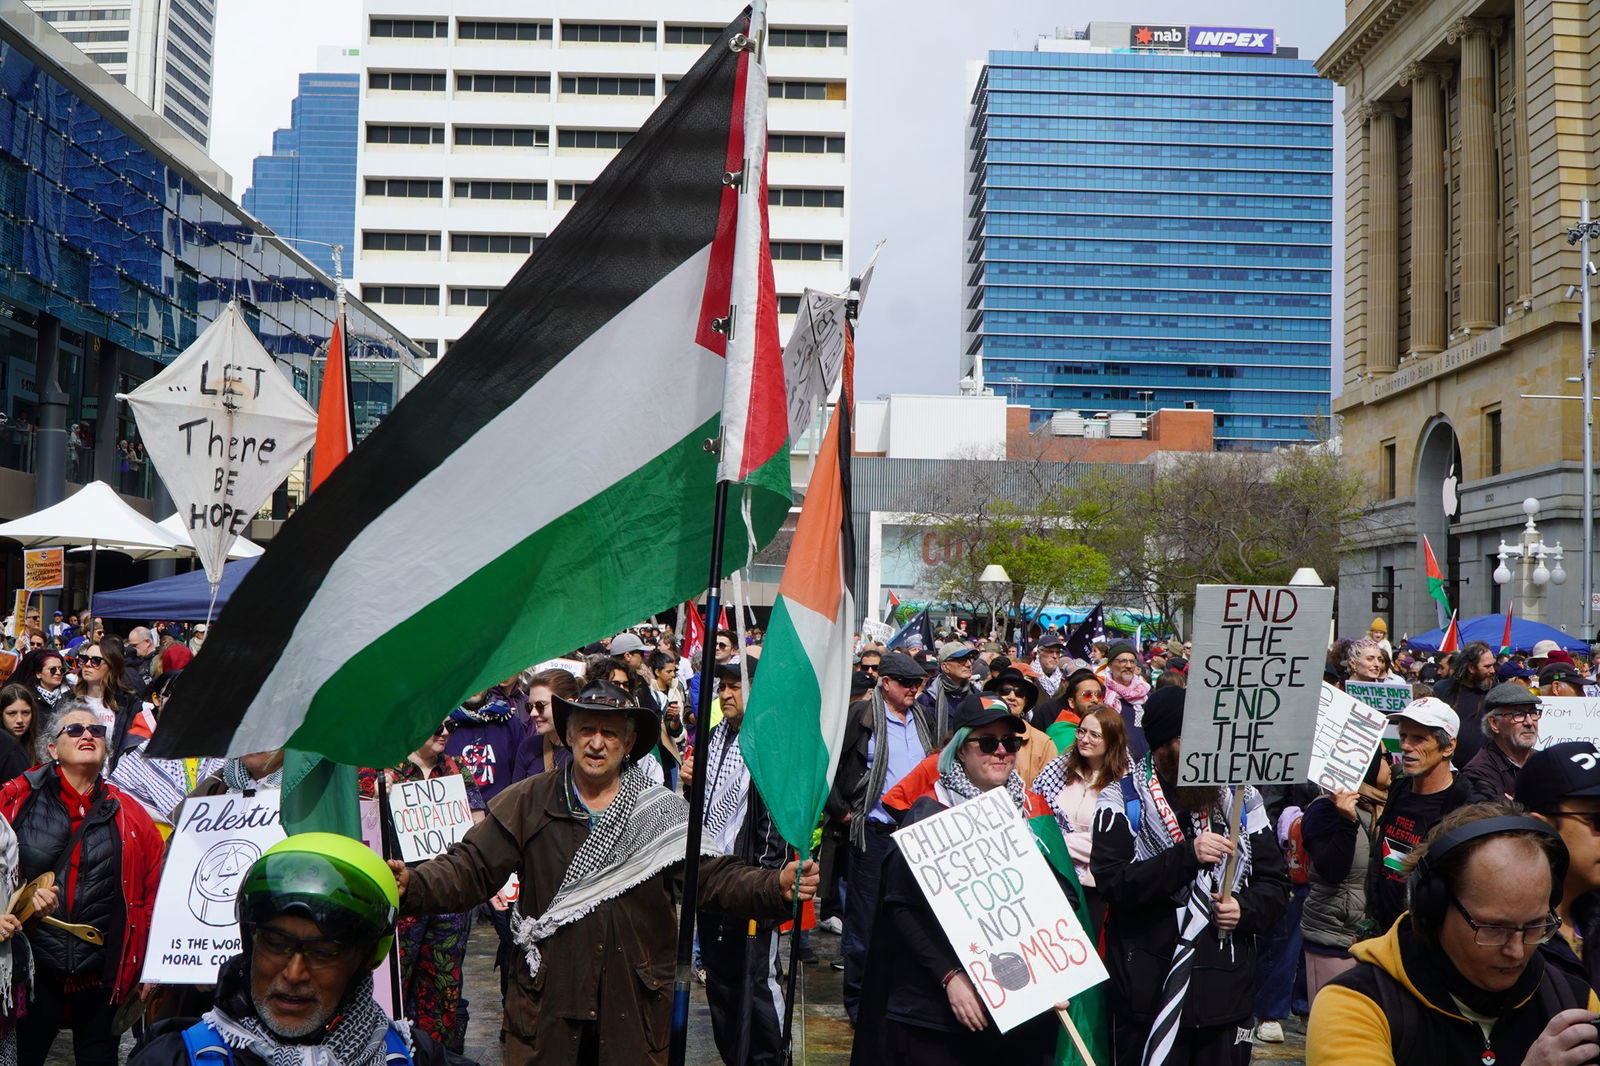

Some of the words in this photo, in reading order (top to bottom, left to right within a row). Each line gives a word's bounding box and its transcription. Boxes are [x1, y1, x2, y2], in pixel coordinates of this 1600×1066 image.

[1154, 28, 1182, 42] nab
[1194, 31, 1268, 47] INPEX
[200, 360, 266, 400] LET
[178, 417, 277, 465] There
[213, 467, 239, 496] BE
[189, 502, 249, 537] HOPE
[1224, 588, 1298, 624] END
[1221, 624, 1293, 656] THE
[1204, 655, 1309, 688] SIEGE
[1212, 687, 1280, 721] END
[1346, 684, 1369, 696] FROM
[1369, 686, 1386, 698] THE
[1386, 687, 1412, 699] RIVER
[1363, 696, 1384, 708] THE
[1386, 698, 1406, 710] SEA
[1212, 721, 1274, 752] THE
[1319, 702, 1386, 792] PALESTINE
[1182, 752, 1300, 784] SILENCE
[402, 779, 446, 808] END
[394, 798, 472, 834] OCCUPATION
[900, 790, 1015, 865] CHILDREN
[1396, 816, 1416, 832] FREE
[413, 827, 455, 857] NOW
[920, 824, 1029, 897] DESERVE
[954, 866, 1024, 920] FOOD
[977, 896, 1035, 946] NOT
[162, 954, 203, 966] MORAL
[171, 938, 182, 950] IS
[187, 938, 208, 950] THE
